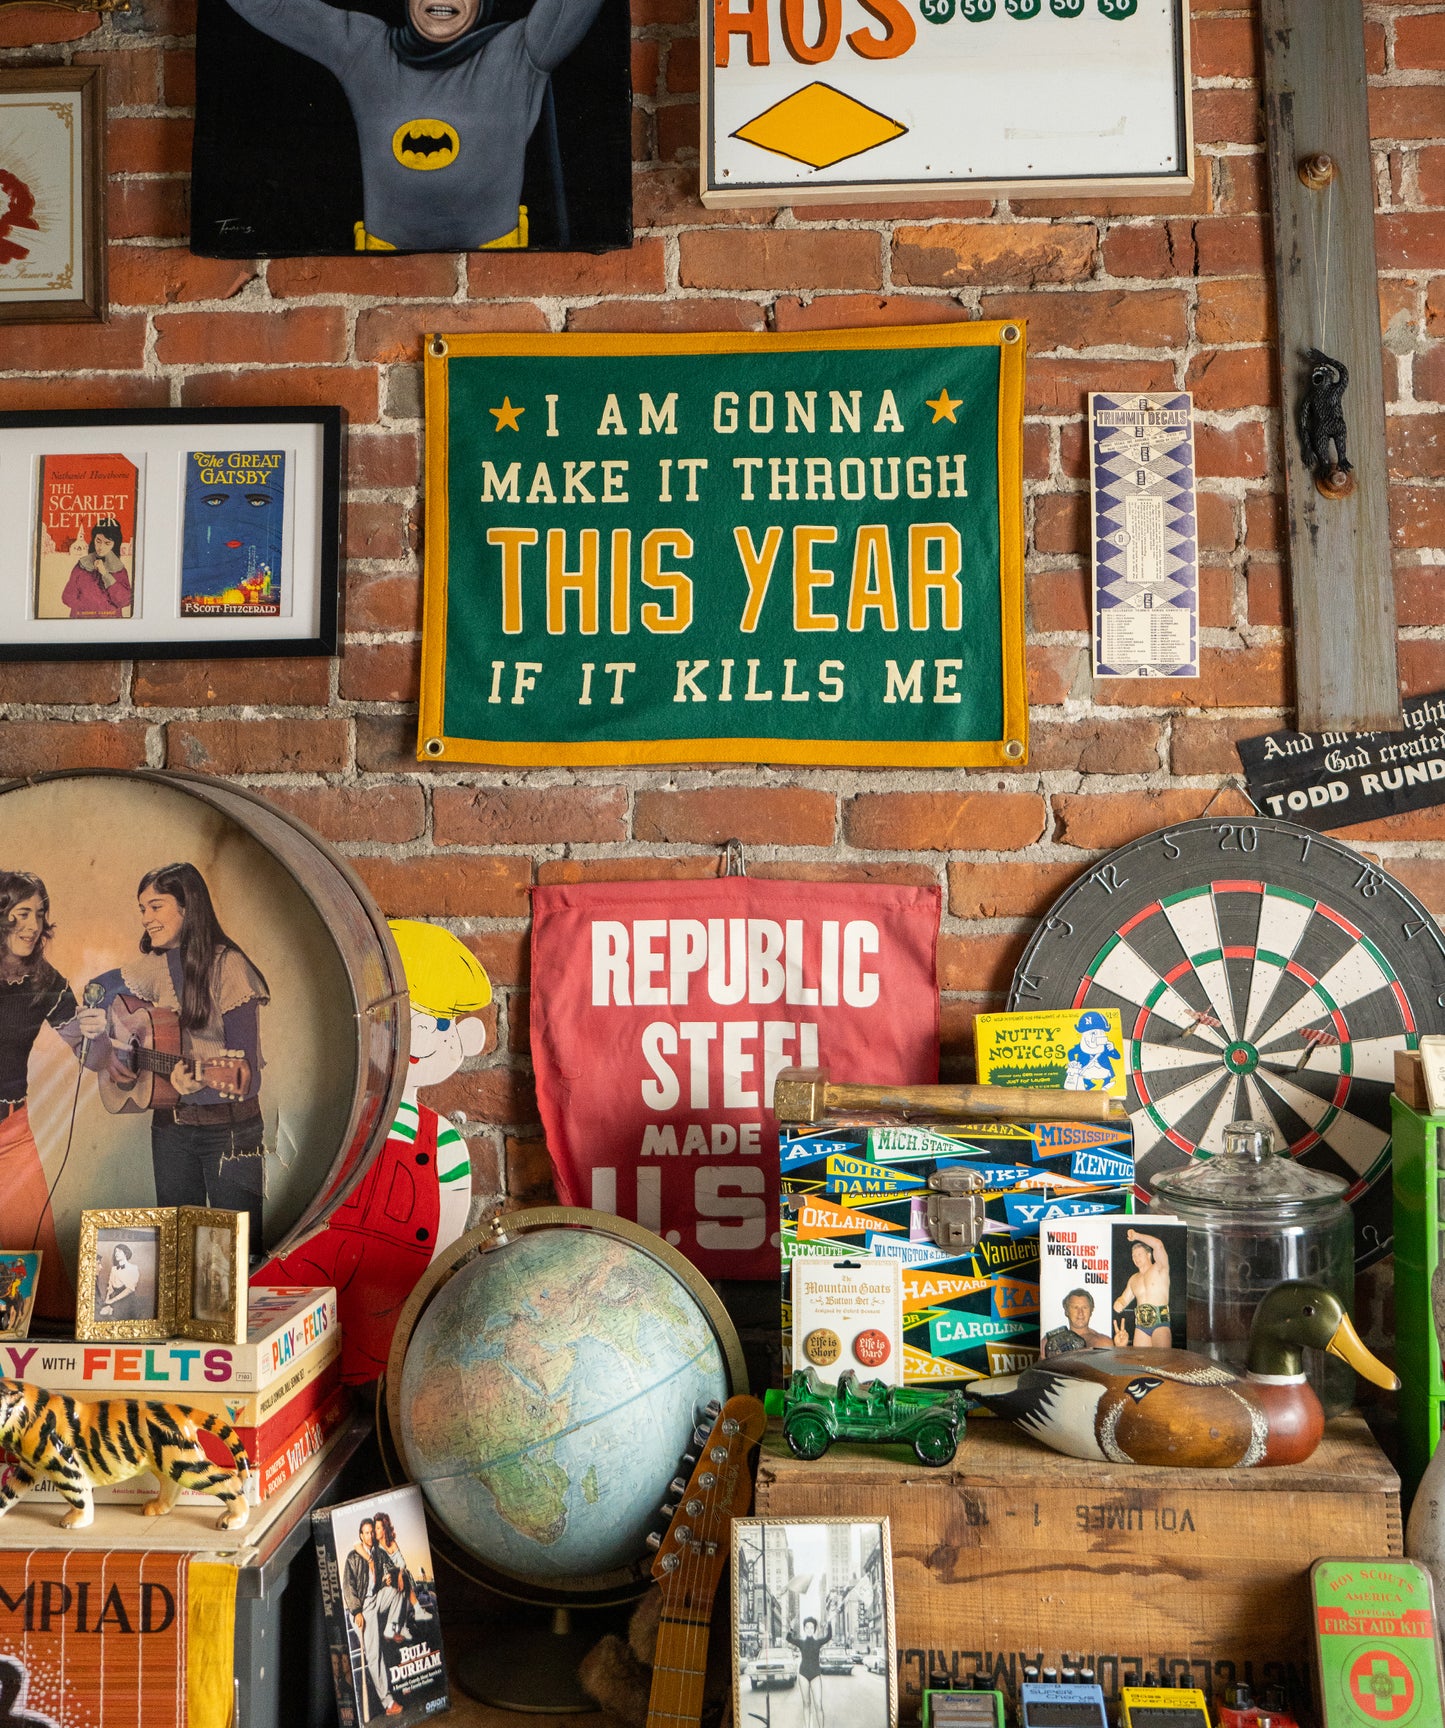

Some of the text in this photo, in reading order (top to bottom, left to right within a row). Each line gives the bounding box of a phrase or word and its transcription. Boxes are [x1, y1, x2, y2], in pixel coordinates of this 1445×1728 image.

[924, 0, 950, 16] 50
[963, 0, 991, 15] 50
[1006, 0, 1034, 13] 50
[1104, 0, 1130, 12] 50
[715, 0, 917, 67] HOS
[545, 389, 904, 437] I AM GONNA
[1098, 411, 1188, 425] TRIMMIT DECALS
[193, 451, 282, 469] The GREAT
[51, 471, 87, 480] Nathaniel
[200, 470, 271, 485] GATSBY
[481, 454, 969, 503] MAKE IT THROUGH
[49, 483, 74, 494] THE
[48, 494, 129, 511] SCARLET
[49, 511, 119, 528] LETTER
[486, 522, 963, 635] THIS YEAR
[488, 658, 963, 705] IF IT KILLS ME
[1403, 700, 1445, 730] ight
[1264, 732, 1314, 761] And
[1325, 727, 1445, 773] God created
[1266, 759, 1445, 816] TODD RUND
[1163, 833, 1180, 860] 5
[1218, 823, 1258, 853] 20
[1088, 863, 1130, 894] 12
[1354, 862, 1385, 898] 18
[1404, 920, 1430, 941] 4
[591, 918, 880, 1007] REPUBLIC
[995, 1027, 1061, 1044] NUTTY
[641, 1123, 762, 1157] MADE
[1039, 1124, 1119, 1147] MISSISSIPPI
[833, 1158, 896, 1179] NOTRE
[834, 1179, 897, 1193] DAME
[802, 1208, 890, 1231] OKLAHOMA
[1013, 1204, 1105, 1224] YALE
[1047, 1231, 1077, 1243] WORLD
[874, 1244, 929, 1262] WASHINGTON
[1047, 1244, 1099, 1257] WRESTLERS'
[1064, 1258, 1109, 1270] '84 COLOR
[804, 1282, 891, 1295] Mountain Goats
[1085, 1272, 1108, 1284] GUIDE
[825, 1296, 869, 1305] Button Set
[902, 1280, 987, 1300] HARVARD
[1001, 1286, 1040, 1309] KA
[272, 1327, 295, 1371] PLAY
[303, 1303, 328, 1345] FELTS
[936, 1321, 1024, 1342] CAROLINA
[810, 1337, 837, 1348] Life is
[810, 1348, 837, 1358] Short
[859, 1338, 885, 1349] Life is
[861, 1348, 883, 1358] Hard
[0, 1347, 39, 1379] Y
[41, 1357, 76, 1370] WITH
[82, 1348, 233, 1382] FELTS
[903, 1357, 955, 1376] EXAS
[316, 1543, 334, 1617] DURHAM
[329, 1559, 339, 1604] BULL
[1329, 1569, 1415, 1594] BOY SCOUTS
[0, 1580, 175, 1634] MPIAD
[1344, 1592, 1403, 1602] AMERICA
[1354, 1609, 1397, 1617] OFFICIAL
[1325, 1618, 1427, 1635] FIRST AID KIT
[399, 1640, 431, 1665] BULL
[389, 1651, 442, 1684] DURHAM
